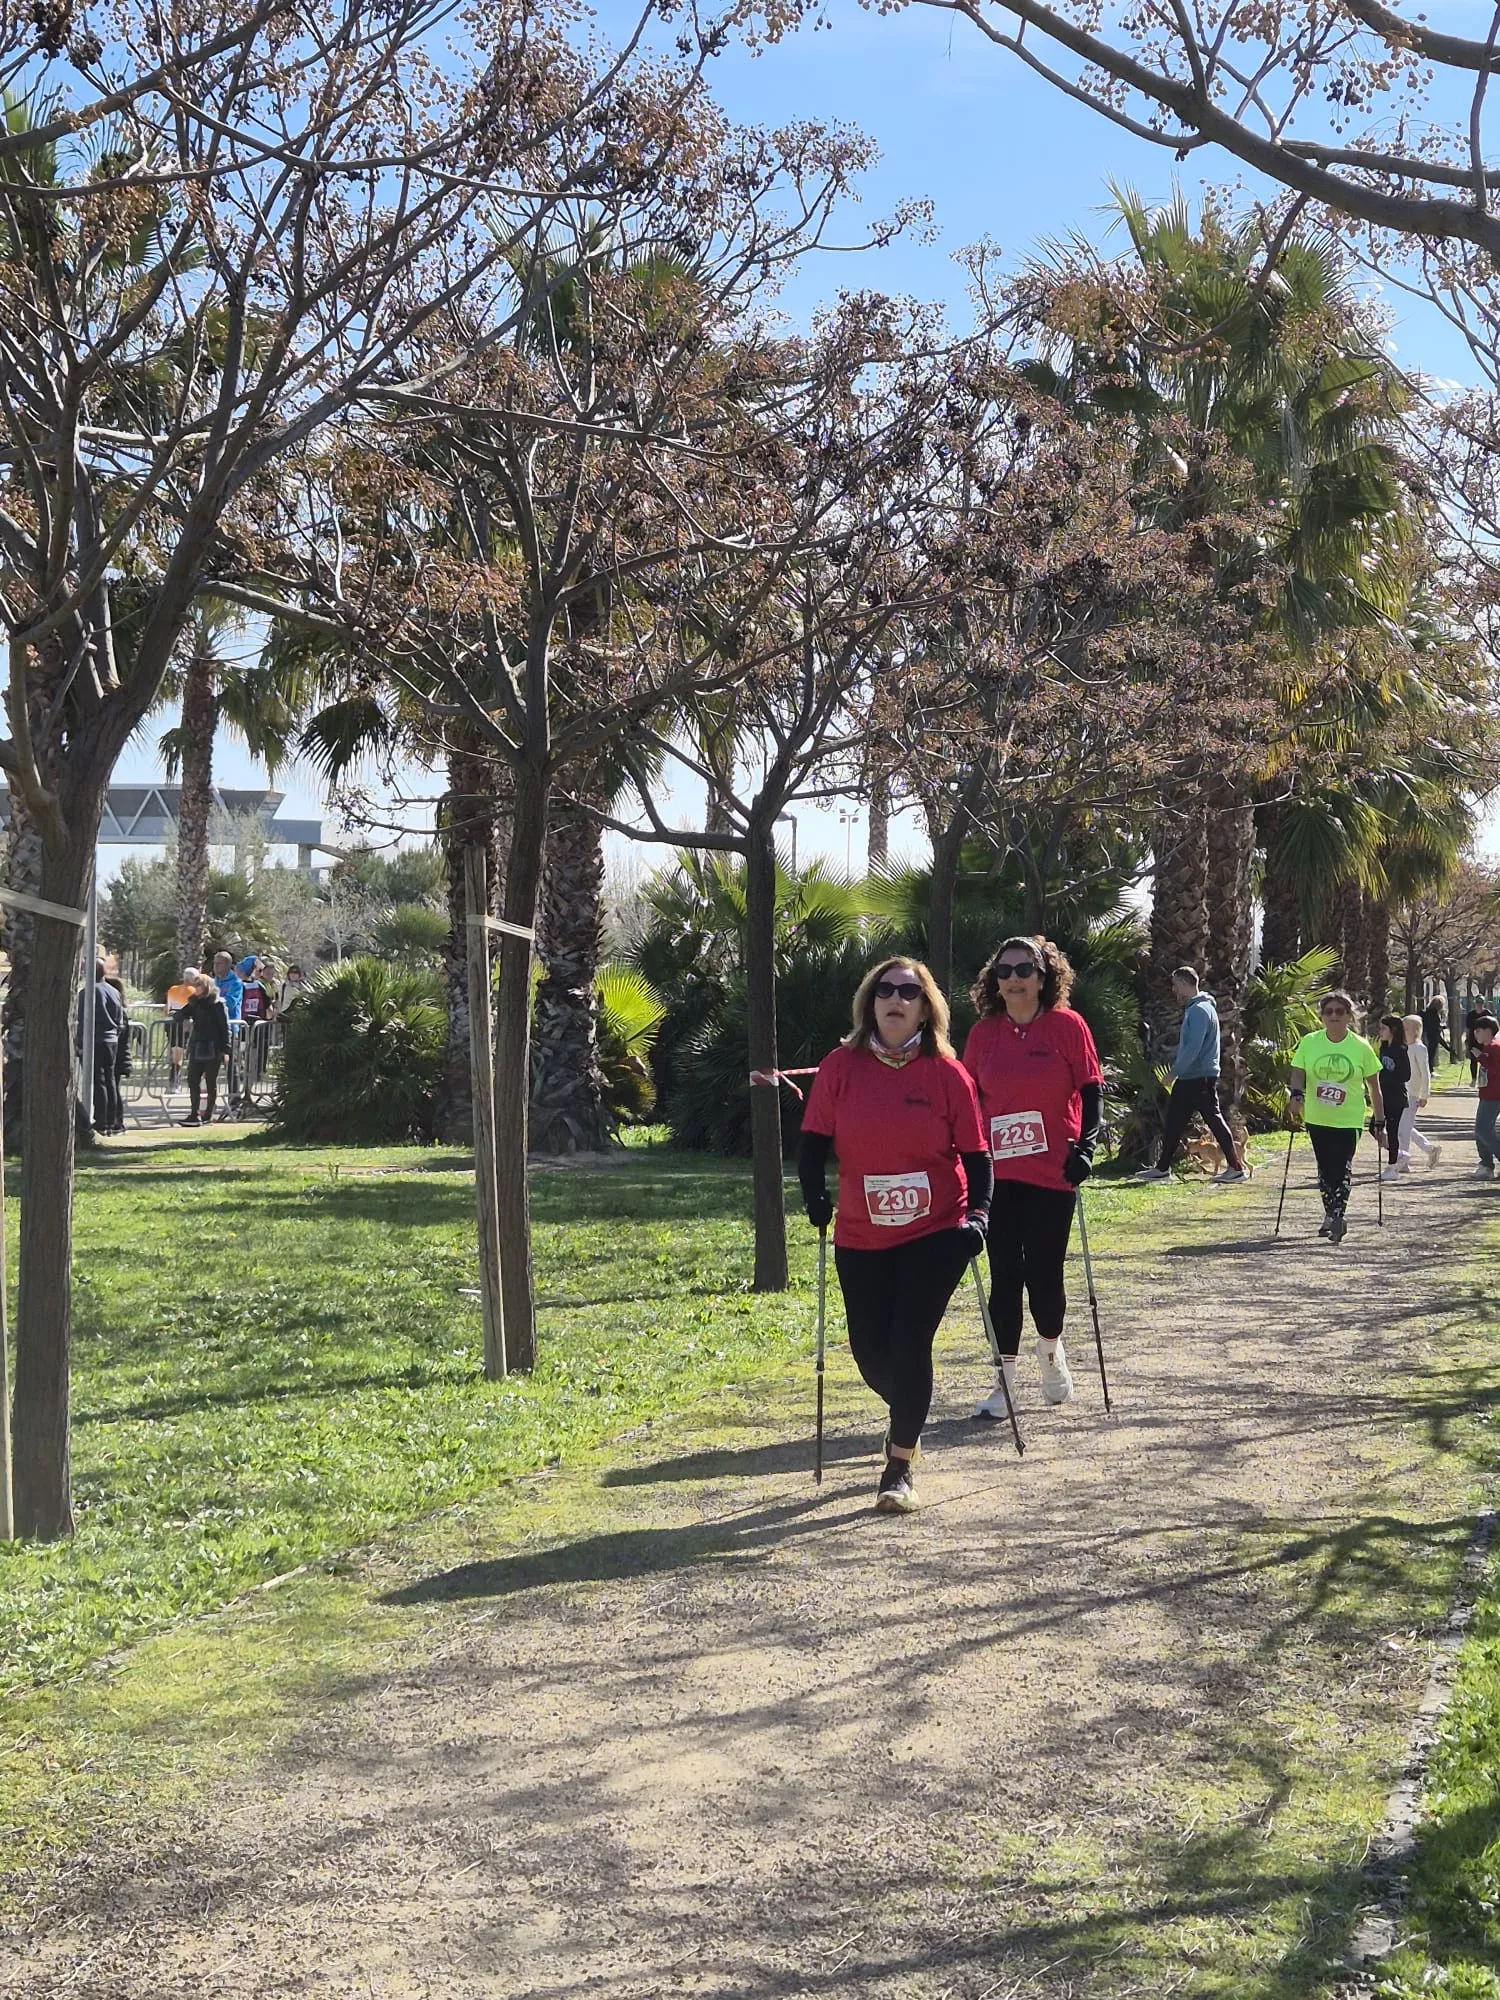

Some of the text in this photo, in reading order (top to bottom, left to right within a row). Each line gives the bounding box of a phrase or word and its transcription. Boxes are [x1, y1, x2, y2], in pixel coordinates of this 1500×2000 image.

[1321, 1088, 1341, 1100] 228
[1000, 1124, 1034, 1145] 226
[877, 1189, 918, 1211] 230
